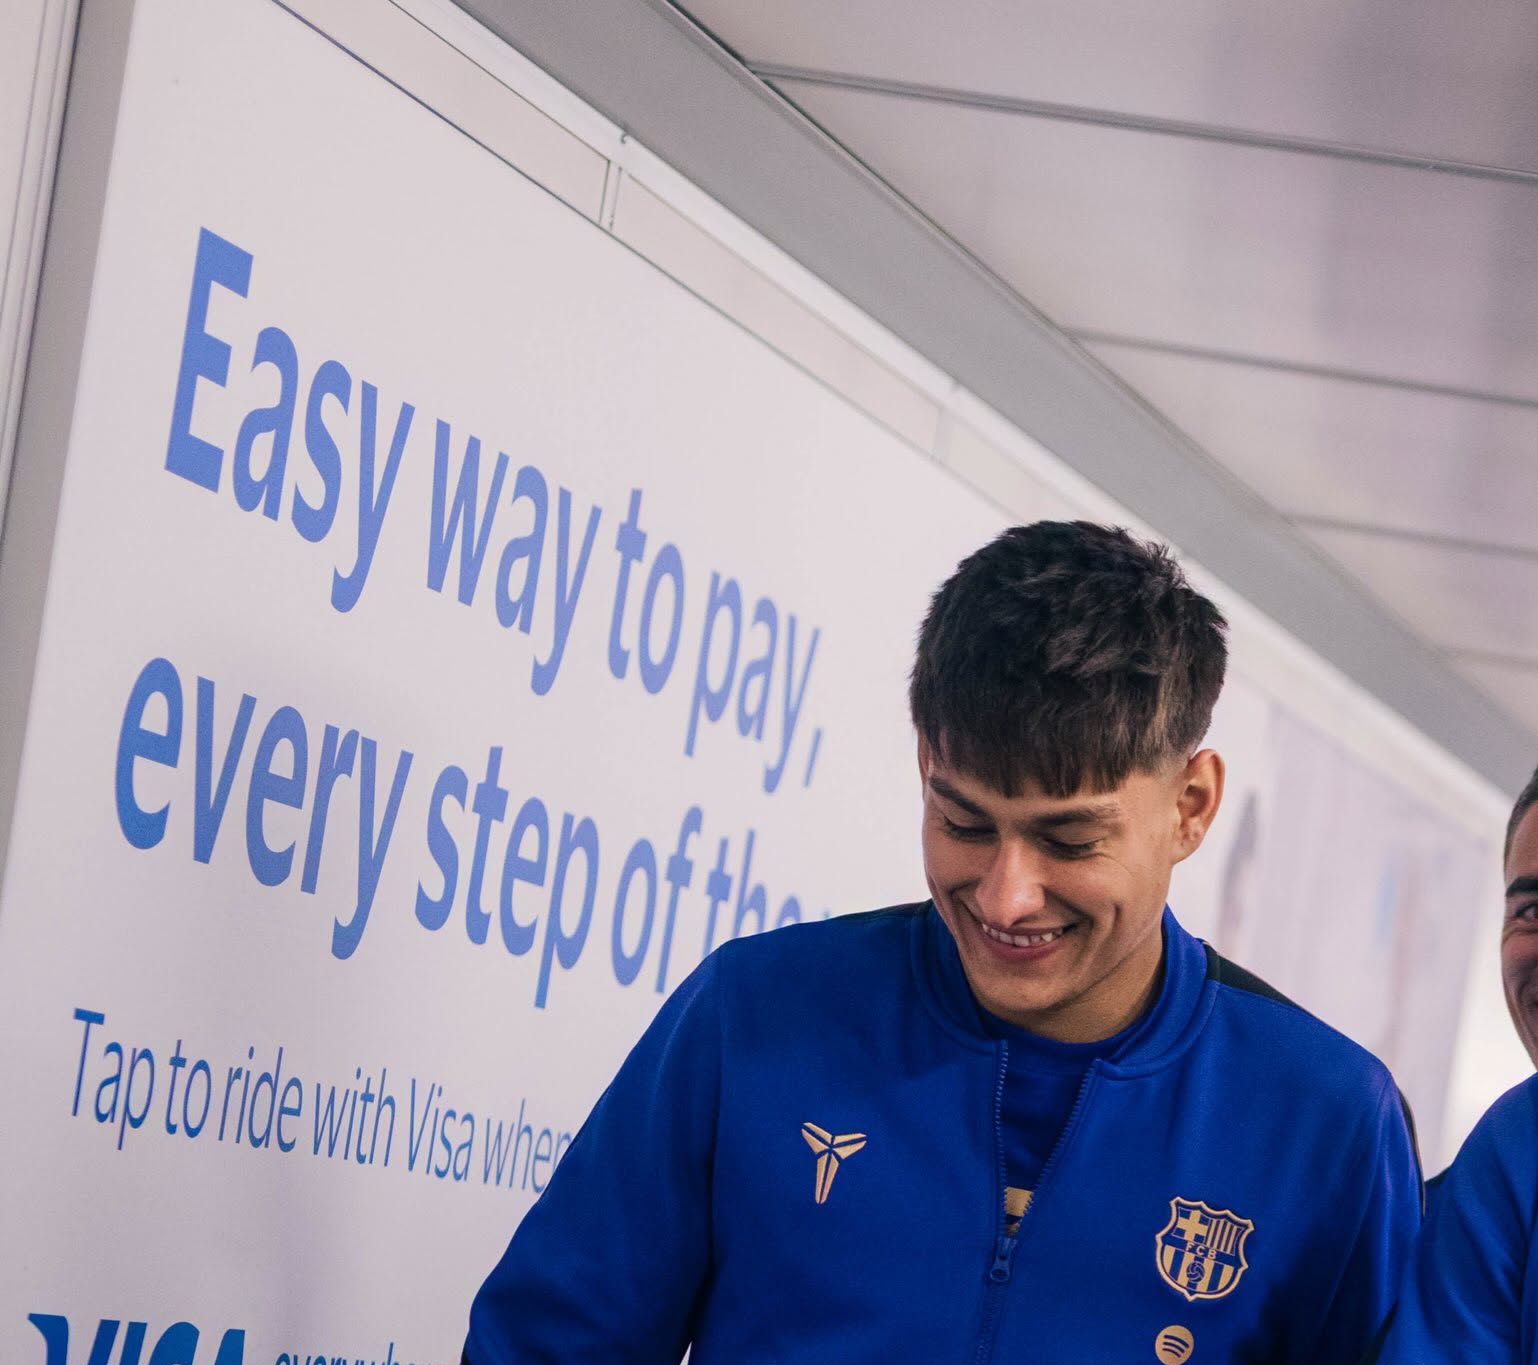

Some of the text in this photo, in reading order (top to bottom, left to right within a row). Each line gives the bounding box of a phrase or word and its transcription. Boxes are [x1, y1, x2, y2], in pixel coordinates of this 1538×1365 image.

[164, 226, 824, 794] Easy way to pay,
[115, 656, 803, 1009] every step of th
[72, 1008, 156, 1150] Tap
[165, 1039, 211, 1139] to
[218, 1046, 302, 1153] ride
[312, 1067, 396, 1168] with
[408, 1078, 474, 1182] Visa
[1186, 1242, 1217, 1259] FCB
